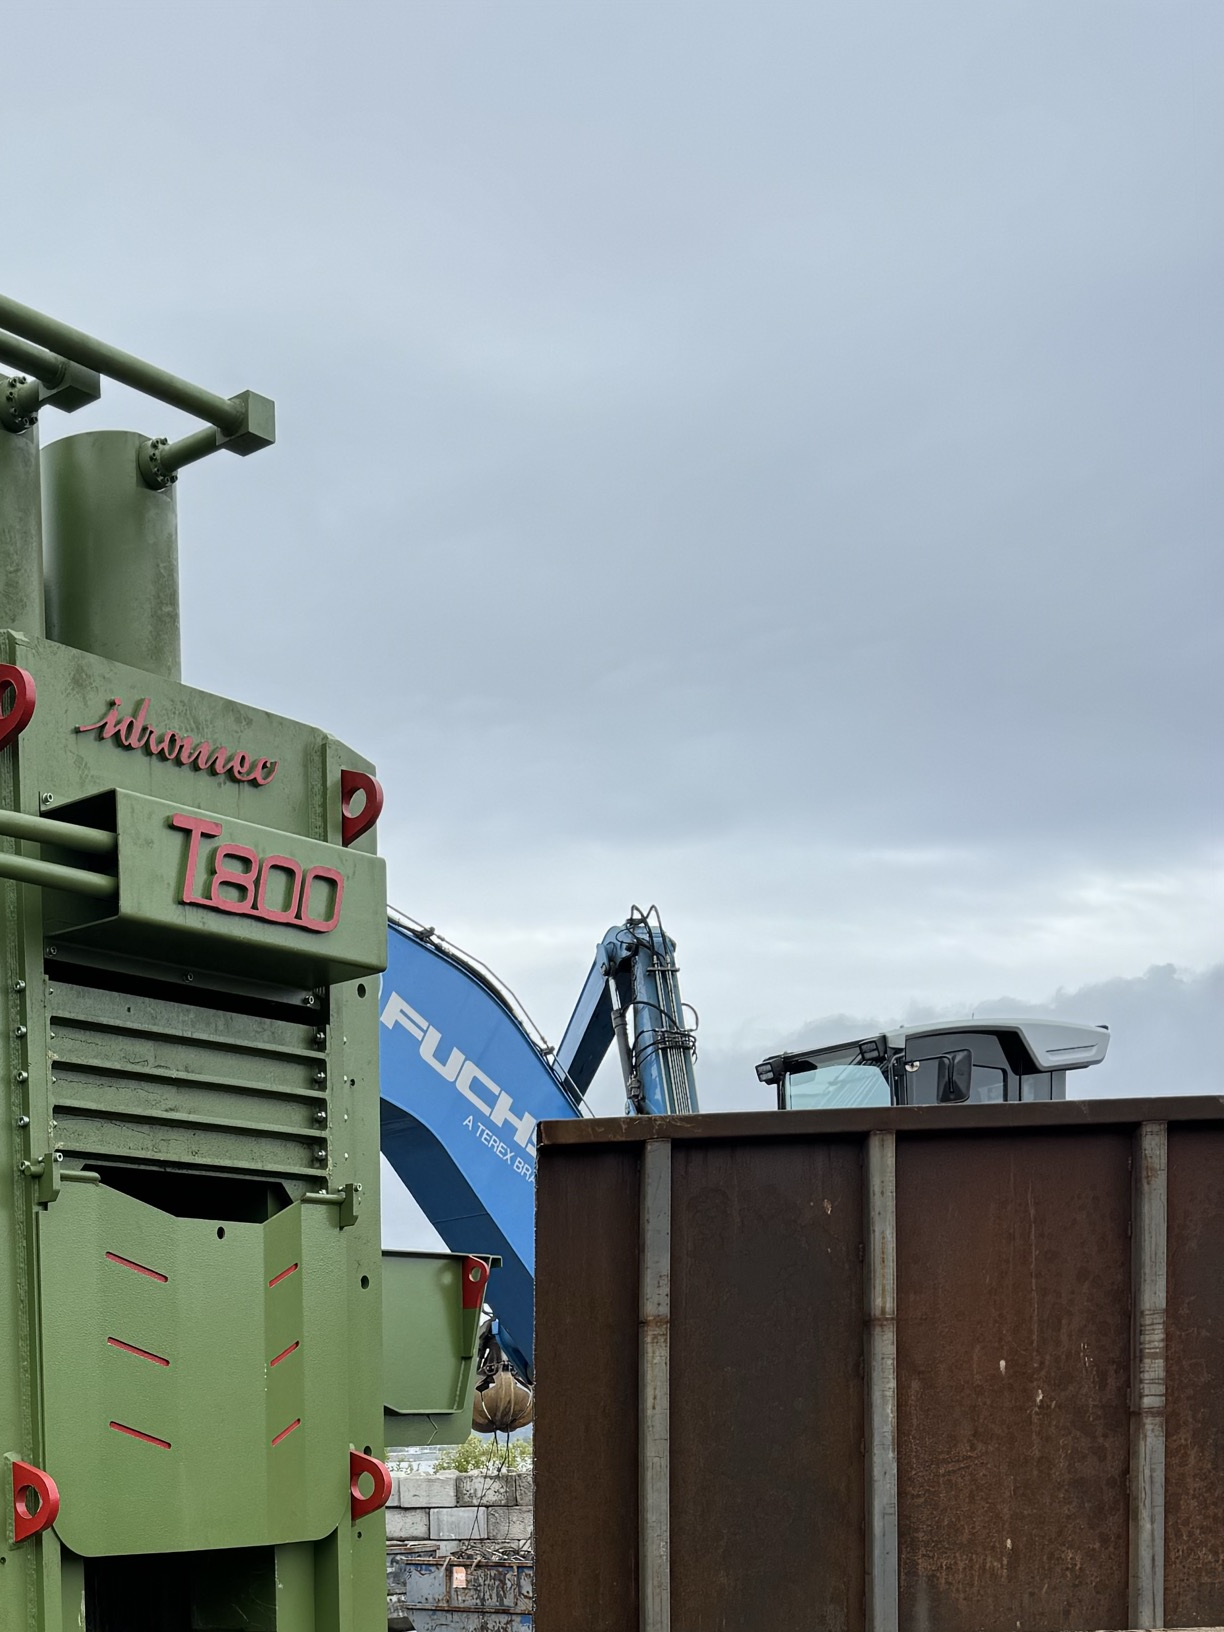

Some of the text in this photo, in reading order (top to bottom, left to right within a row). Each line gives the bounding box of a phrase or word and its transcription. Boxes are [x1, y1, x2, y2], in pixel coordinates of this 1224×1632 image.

[170, 812, 345, 933] T800
[463, 1115, 474, 1131] A
[476, 1122, 515, 1165] TEREX
